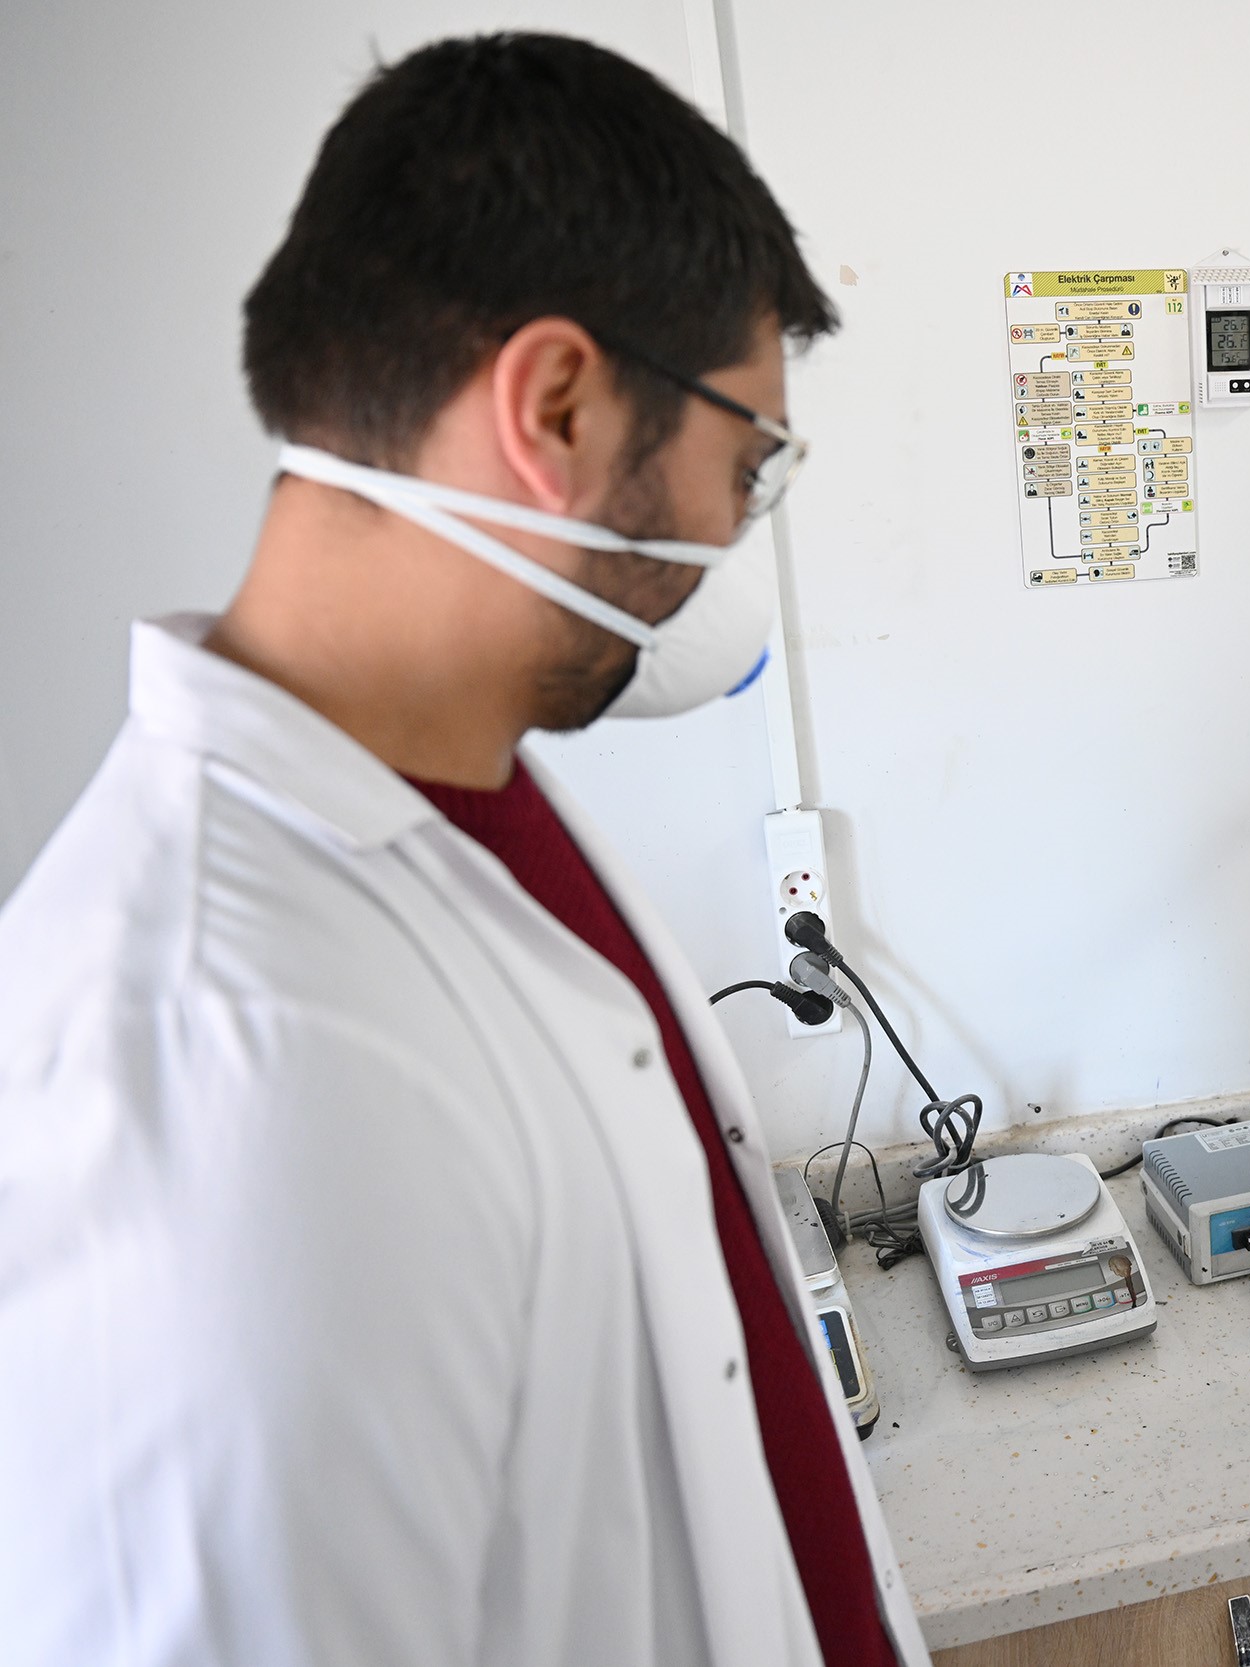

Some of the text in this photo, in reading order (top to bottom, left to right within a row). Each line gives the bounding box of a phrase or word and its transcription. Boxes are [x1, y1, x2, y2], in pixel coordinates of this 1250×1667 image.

[1058, 275, 1135, 284] Elektrik Çarpması
[1167, 303, 1183, 313] 112
[976, 1273, 998, 1283] AXIS
